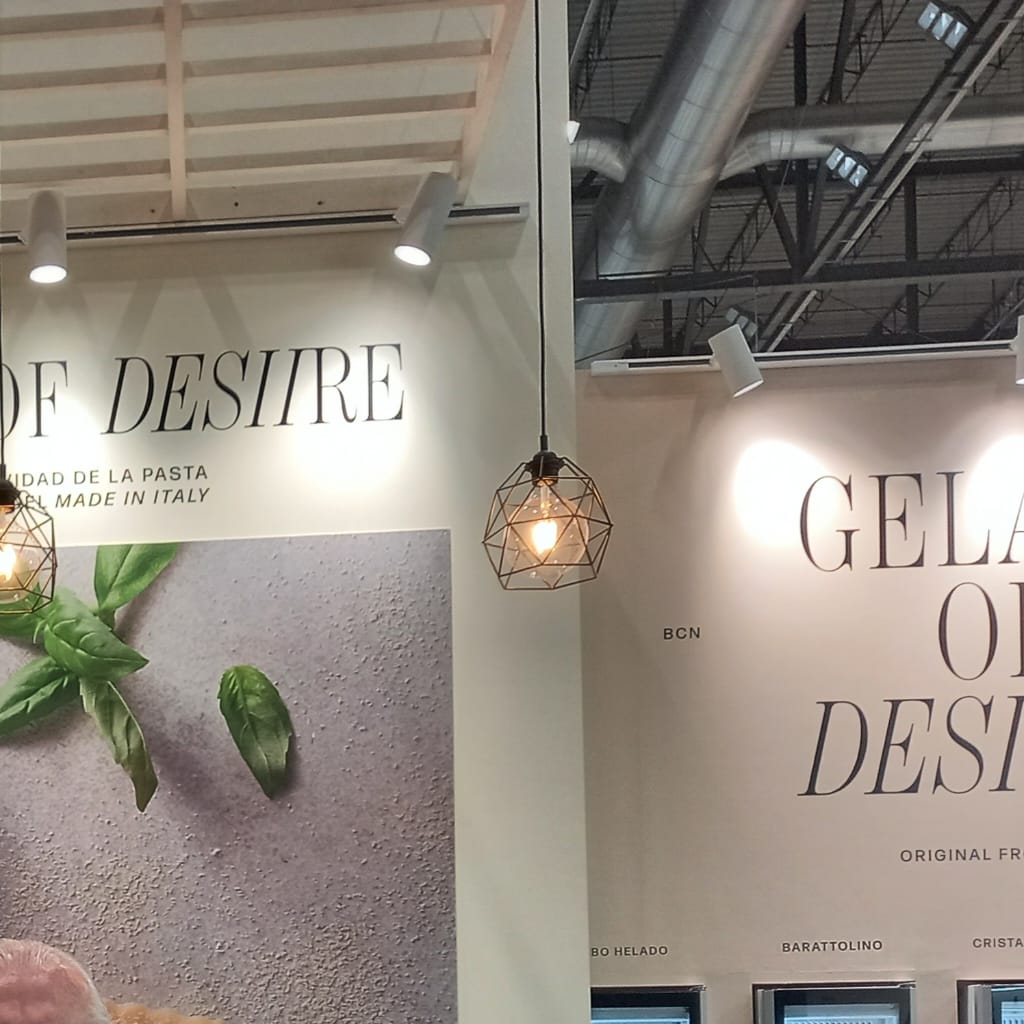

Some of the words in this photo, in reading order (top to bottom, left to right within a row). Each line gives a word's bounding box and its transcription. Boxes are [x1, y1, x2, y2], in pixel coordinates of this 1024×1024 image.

[101, 343, 404, 435] DESIIRE
[74, 469, 100, 485] DE
[109, 468, 134, 484] LA
[142, 465, 208, 482] PASTA
[55, 491, 117, 509] MADE
[124, 490, 146, 506] IN
[153, 487, 211, 505] ITALY
[663, 626, 701, 641] BCN
[900, 848, 992, 862] ORIGINAL
[999, 847, 1024, 861] FR
[782, 939, 883, 953] BARATTOLINO
[972, 937, 1024, 949] CRISTA
[614, 945, 668, 957] HELADO
